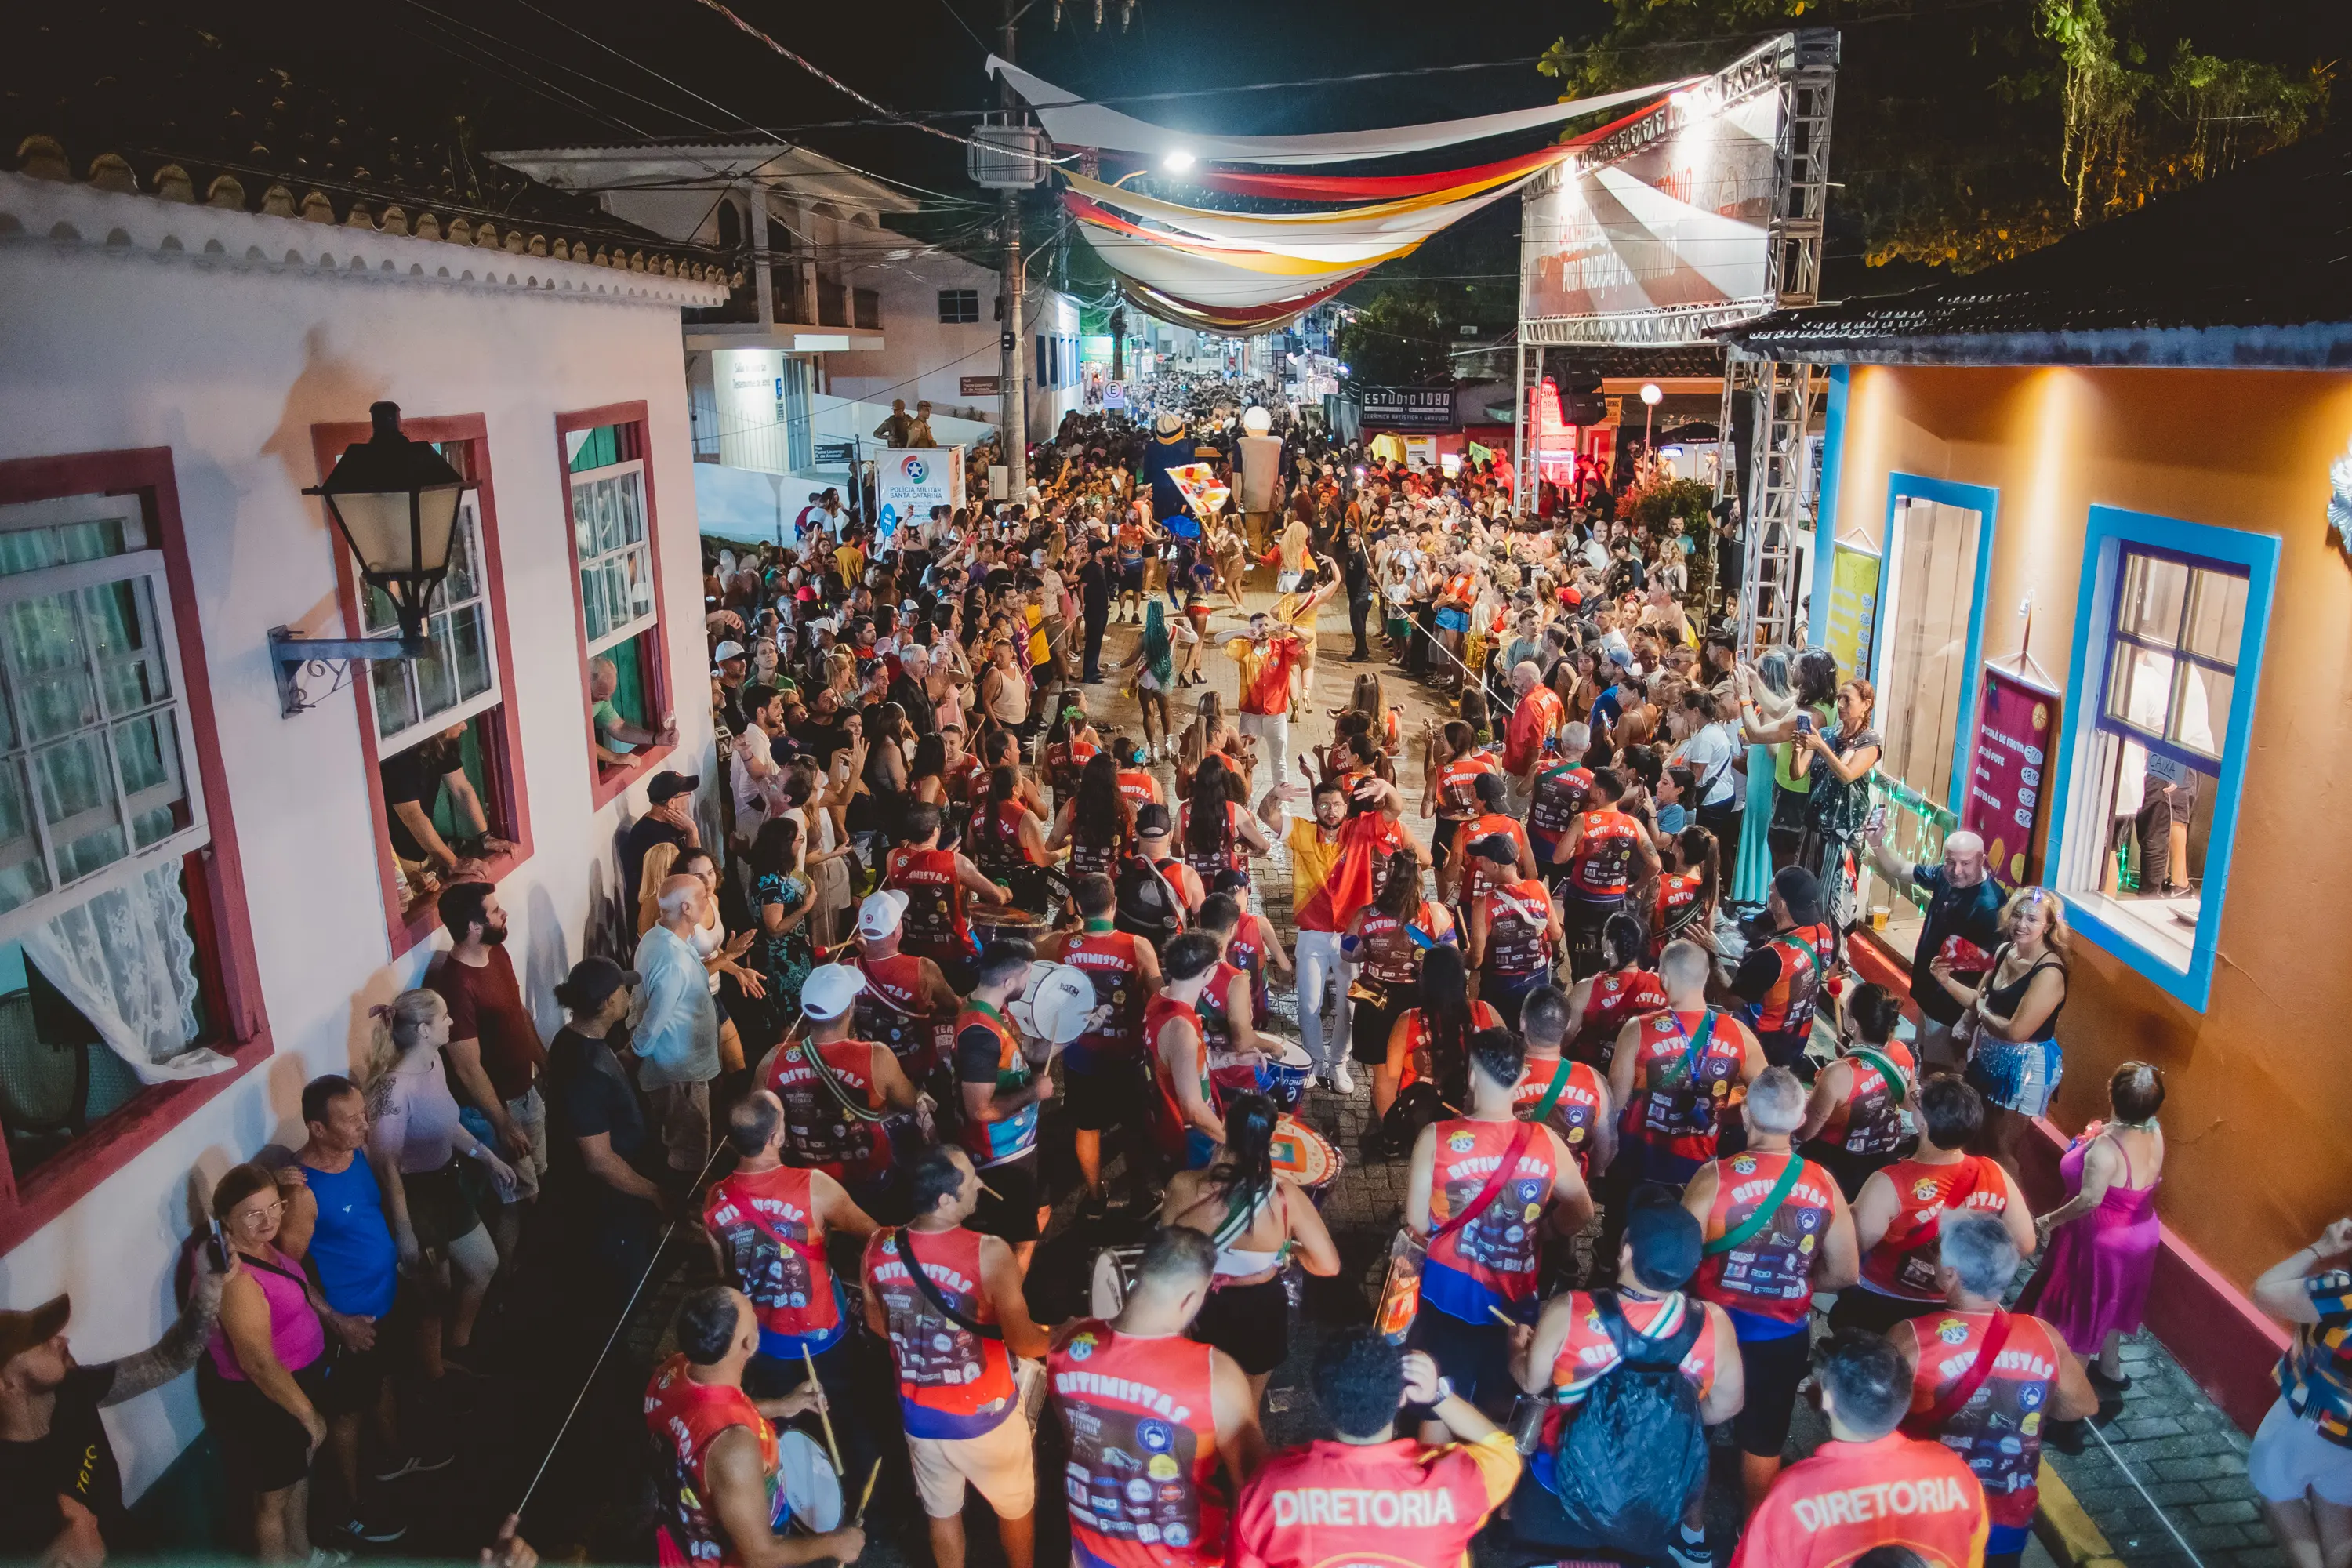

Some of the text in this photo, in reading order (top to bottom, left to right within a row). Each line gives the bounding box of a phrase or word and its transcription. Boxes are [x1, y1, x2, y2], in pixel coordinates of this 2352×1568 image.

[1563, 258, 1581, 292] PURA
[1110, 385, 1116, 395] E
[1999, 733, 2007, 745] DE
[1991, 751, 2005, 766] POTE
[1064, 953, 1134, 971] RITIMISTAS
[1055, 1371, 1191, 1423] RITIMISTAS
[1273, 1487, 1456, 1527] DIRETORIA
[1792, 1477, 1969, 1533] DIRETORIA
